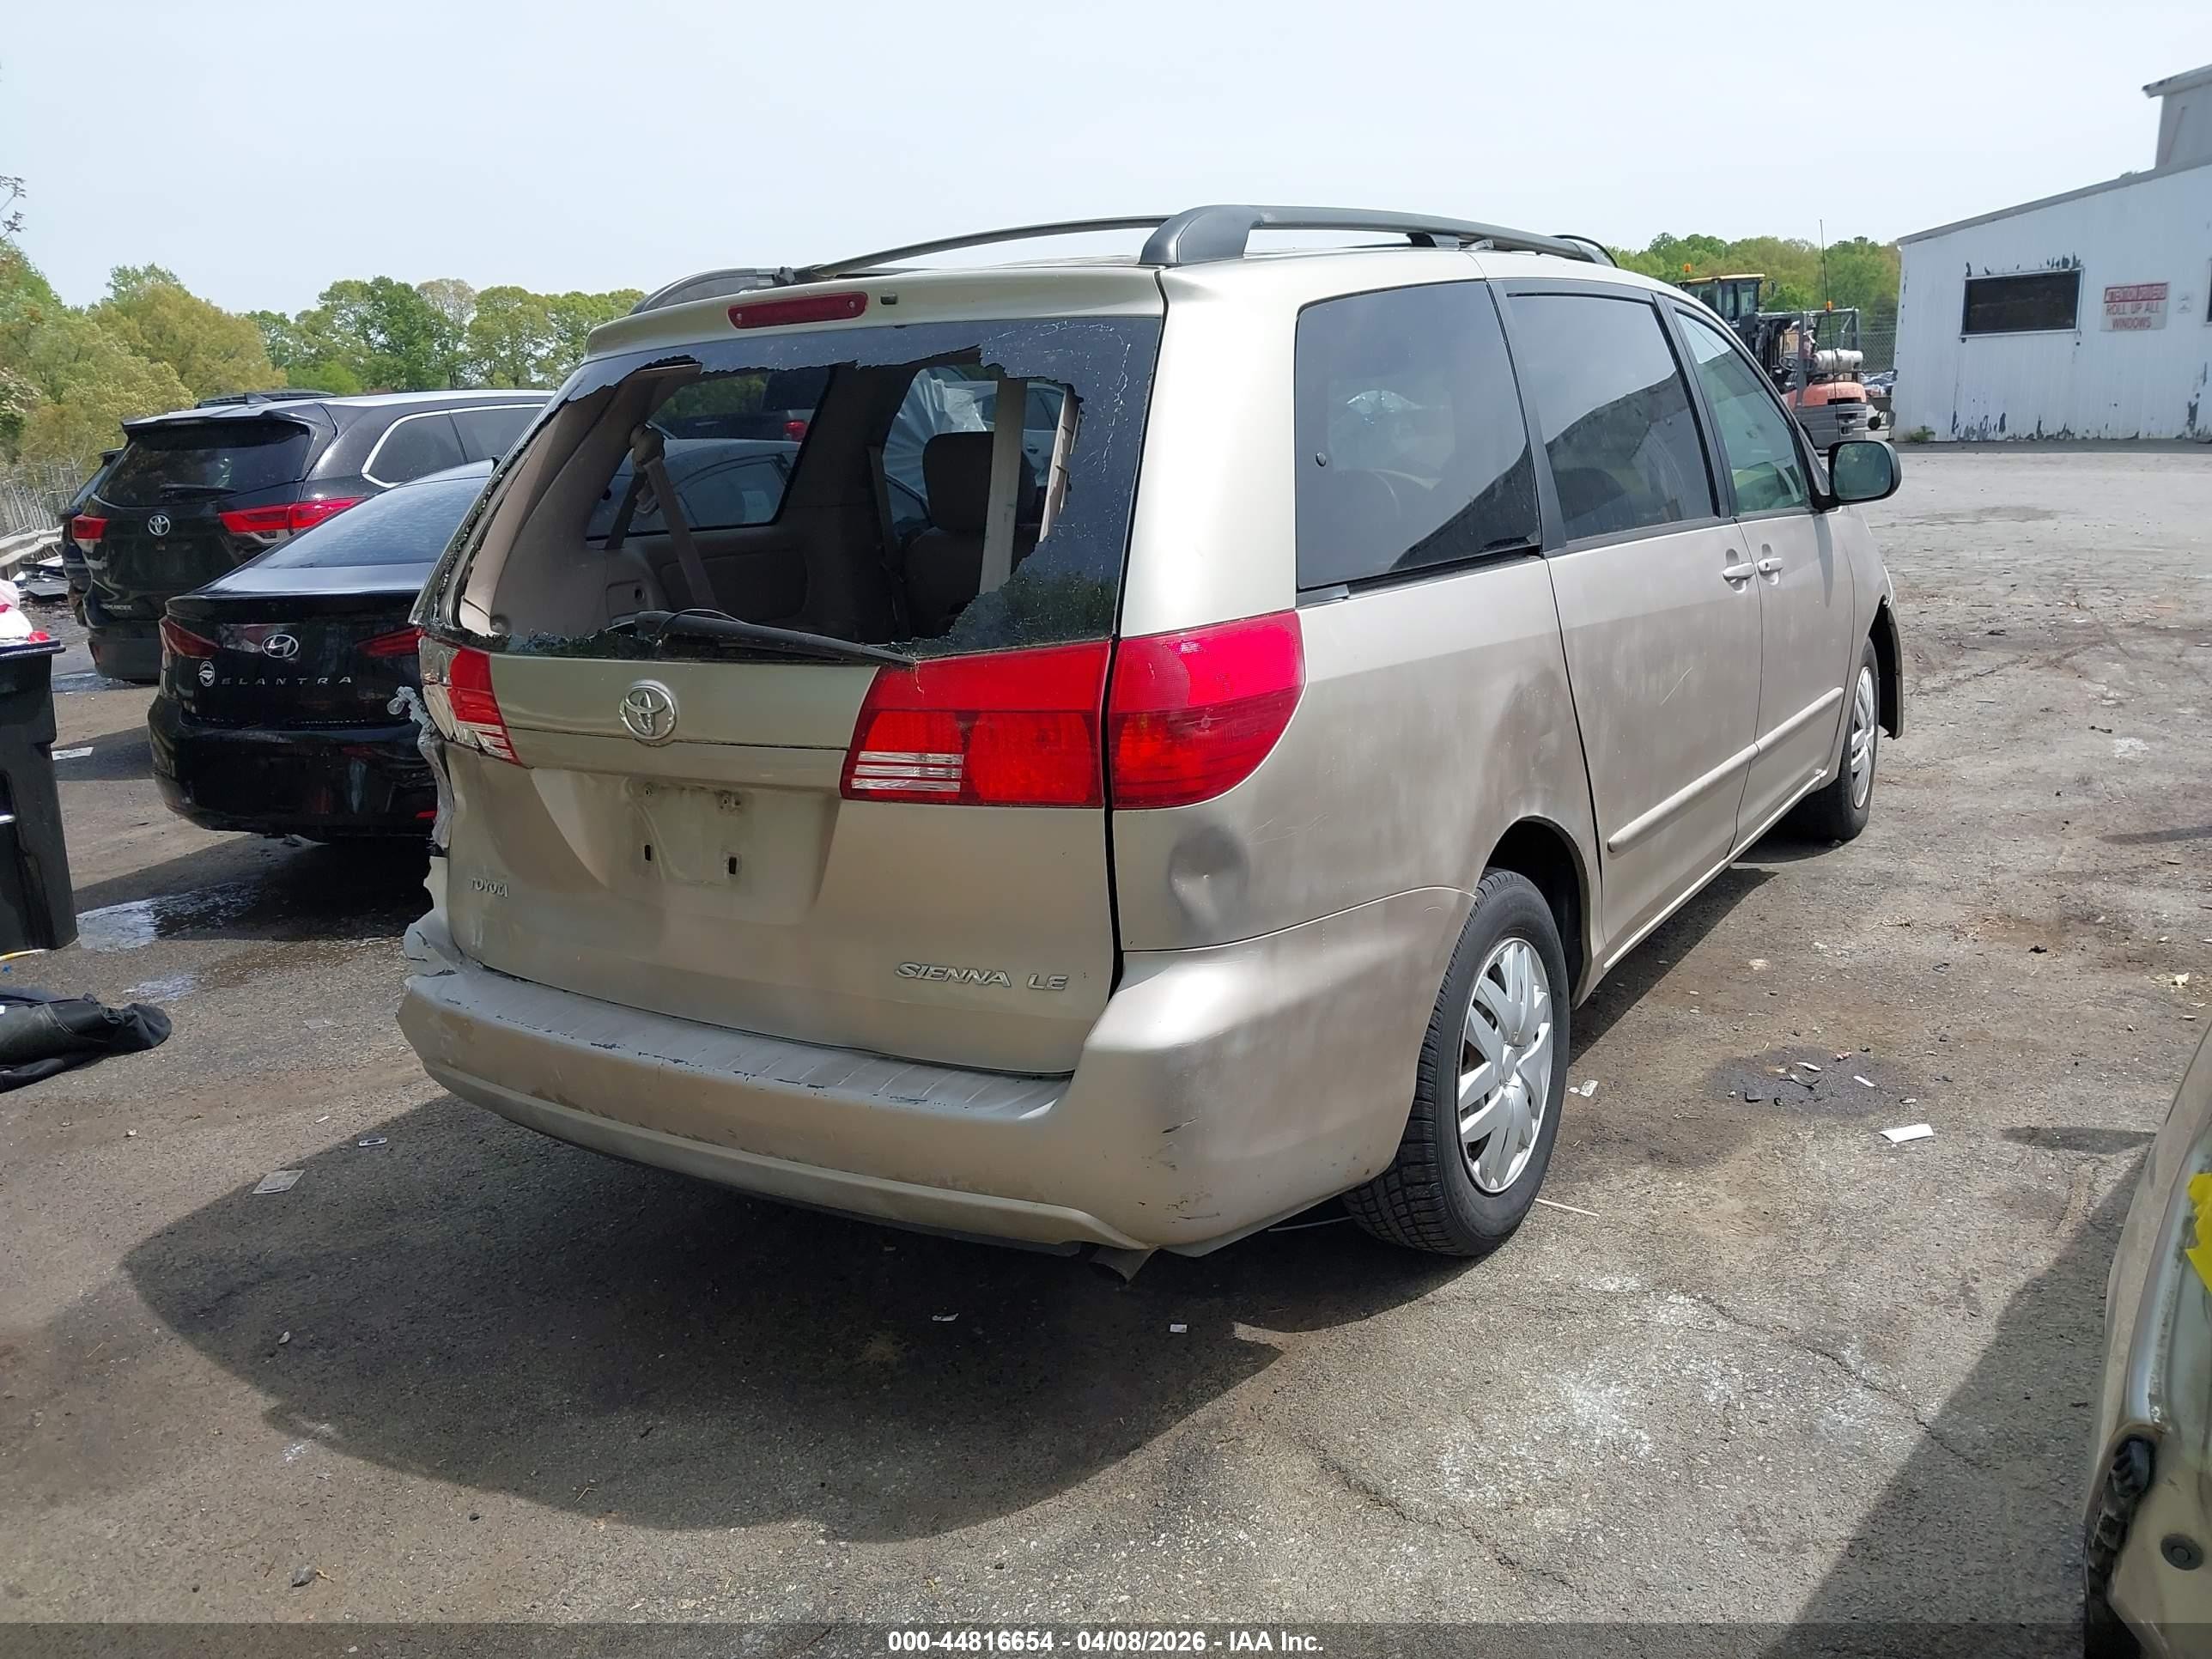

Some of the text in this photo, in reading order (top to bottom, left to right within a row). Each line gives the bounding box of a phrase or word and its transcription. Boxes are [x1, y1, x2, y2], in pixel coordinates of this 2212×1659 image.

[2106, 301, 2160, 316] ROLL UP ALL
[2112, 318, 2152, 330] WINDOWS
[221, 676, 352, 687] ELANTRA
[471, 878, 509, 898] TOYOTA
[895, 962, 1069, 991] SIENNA LE
